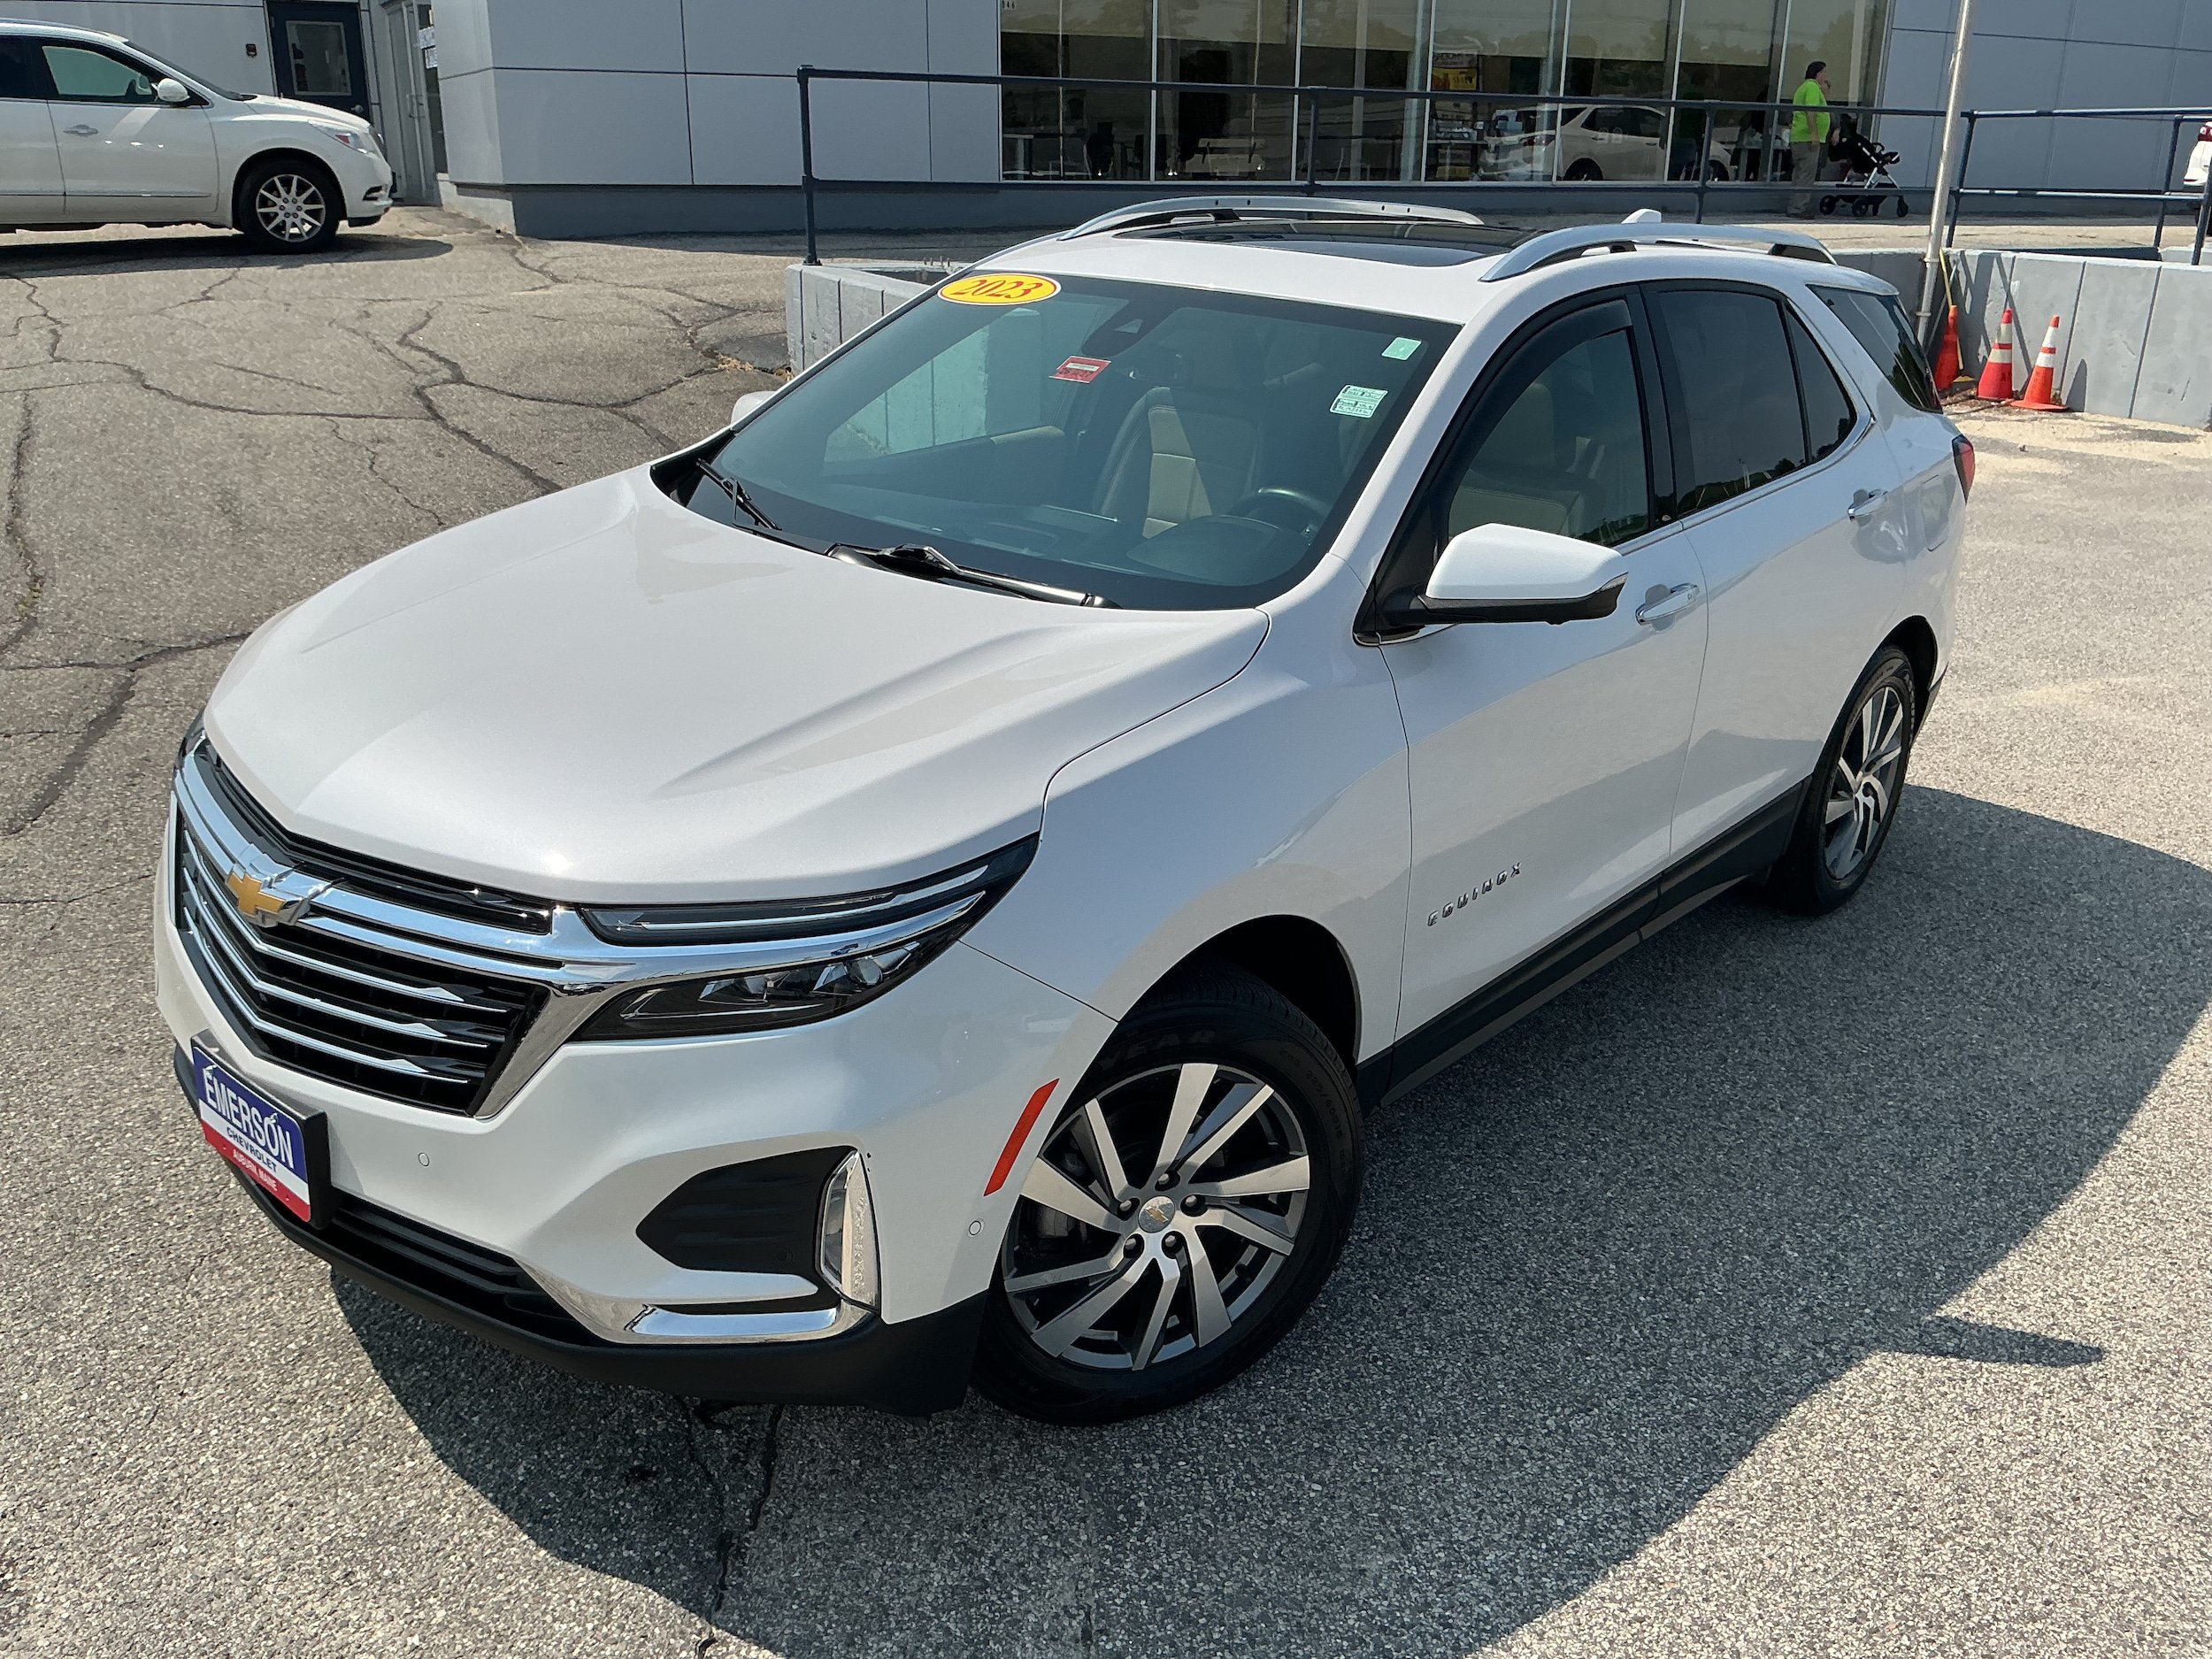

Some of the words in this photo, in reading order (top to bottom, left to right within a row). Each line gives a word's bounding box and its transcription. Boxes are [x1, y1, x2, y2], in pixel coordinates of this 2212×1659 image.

[949, 280, 1043, 299] 2023
[1427, 862, 1522, 927] EQUINOX
[203, 1066, 295, 1170] EMERSON
[227, 1126, 277, 1173] CHEVROLET
